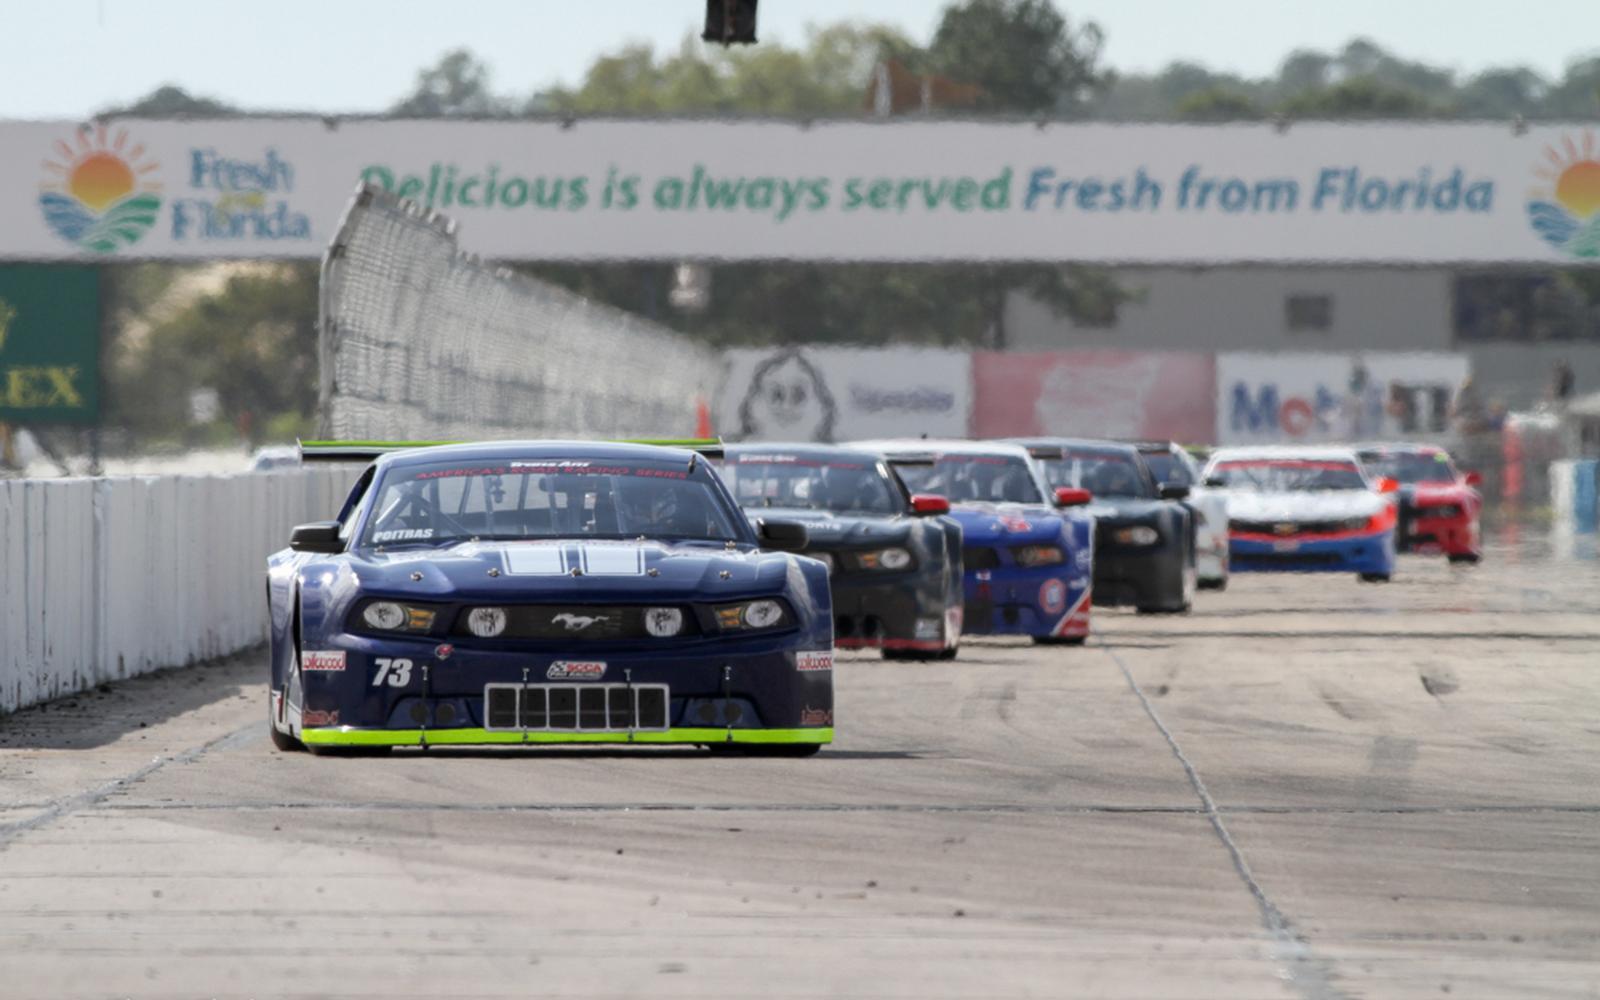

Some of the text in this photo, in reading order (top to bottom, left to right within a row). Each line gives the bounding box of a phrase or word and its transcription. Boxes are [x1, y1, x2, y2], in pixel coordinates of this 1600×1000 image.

[190, 148, 294, 192] Fresh
[602, 164, 640, 210] is
[653, 164, 830, 222] always
[842, 166, 1013, 211] served
[1023, 166, 1162, 211] Fresh
[1175, 165, 1299, 211] from
[1311, 166, 1494, 212] Florida
[171, 199, 310, 241] Florida
[0, 367, 83, 408] EX
[563, 466, 630, 475] RACING
[636, 468, 687, 480] SERIES
[372, 528, 434, 543] POITRAS
[371, 657, 413, 688] 73
[566, 662, 602, 673] SCCA
